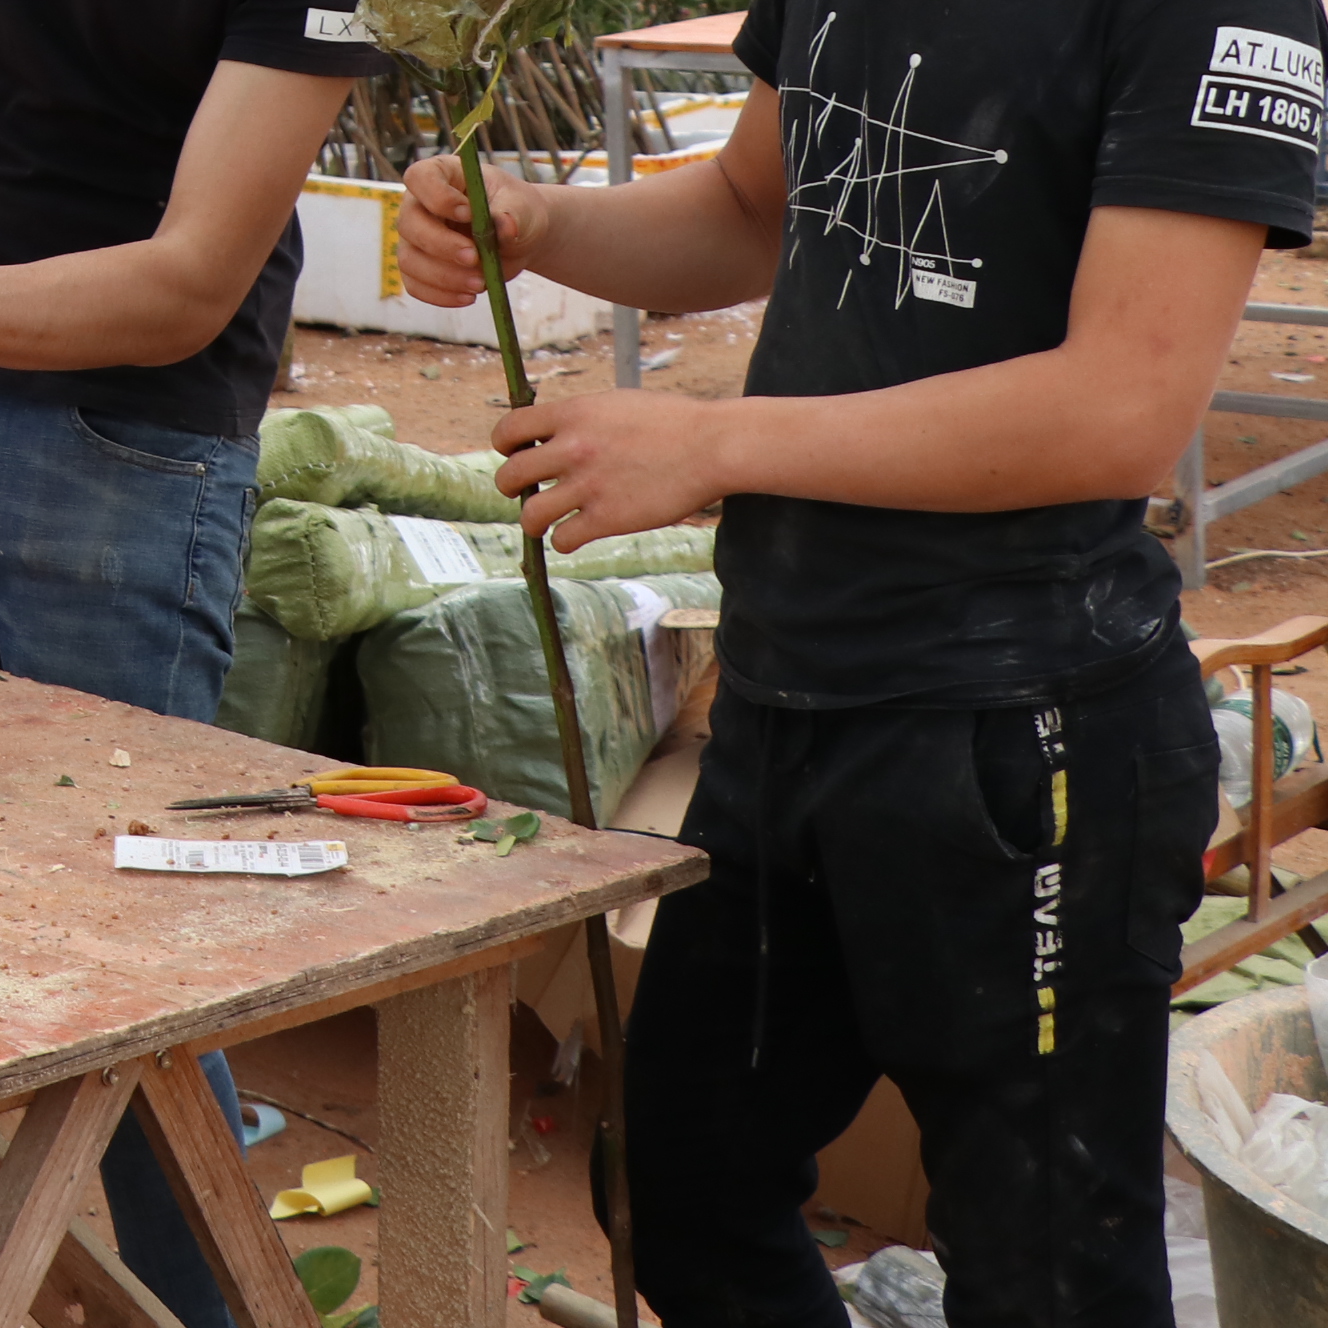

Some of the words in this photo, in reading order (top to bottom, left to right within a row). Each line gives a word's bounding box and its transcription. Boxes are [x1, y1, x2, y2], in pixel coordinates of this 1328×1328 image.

[1220, 39, 1322, 87] AT.LUKE
[1204, 87, 1250, 118] LH
[1258, 95, 1311, 133] 1805
[916, 275, 935, 284] NEW
[937, 279, 968, 292] FASHION
[1033, 863, 1062, 982] TEAM
